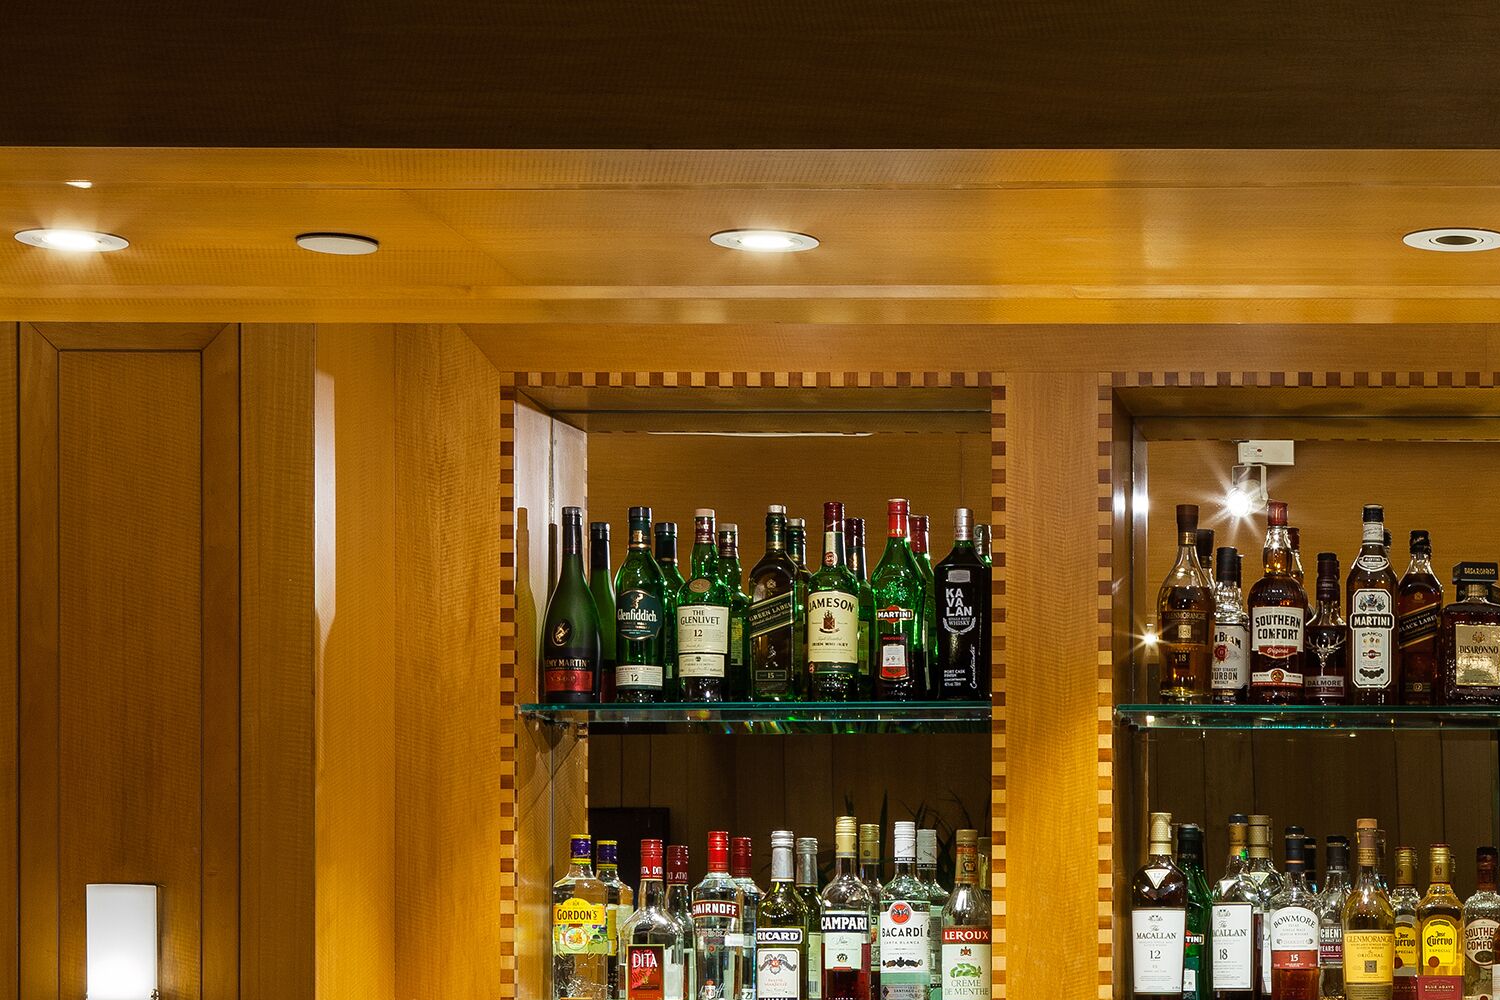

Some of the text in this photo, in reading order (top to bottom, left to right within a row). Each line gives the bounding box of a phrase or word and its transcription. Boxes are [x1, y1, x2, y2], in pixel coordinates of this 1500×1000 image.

[945, 588, 964, 598] KA
[808, 597, 854, 613] JAMESON
[945, 598, 964, 607] VA
[618, 608, 657, 622] Glenfiddich
[749, 610, 771, 622] GREEN
[946, 606, 972, 617] LAN
[680, 616, 720, 626] GLENLIVET
[1255, 614, 1301, 628] SOUTHERN
[1354, 616, 1390, 626] MARTINI
[694, 629, 703, 637] 12
[1257, 627, 1298, 640] COMFORT
[1459, 644, 1498, 655] DISARONNO
[556, 659, 587, 667] MARTIN
[631, 673, 639, 681] 12
[556, 908, 598, 920] GORDON'S
[692, 902, 737, 916] SMIRNOFF
[821, 916, 868, 931] CAMPARI
[1273, 913, 1316, 929] BOWMORE
[881, 923, 924, 938] BACARDÍ
[944, 931, 989, 941] LEROUX
[1136, 932, 1177, 940] MACALLAN
[757, 931, 799, 942] RICARD
[1426, 935, 1453, 947] Cuervo
[1149, 950, 1161, 960] 12
[1218, 948, 1228, 961] 18
[1289, 954, 1299, 962] 15
[632, 952, 658, 969] DITA
[951, 976, 981, 987] CRÈME
[955, 987, 989, 996] MENTHE
